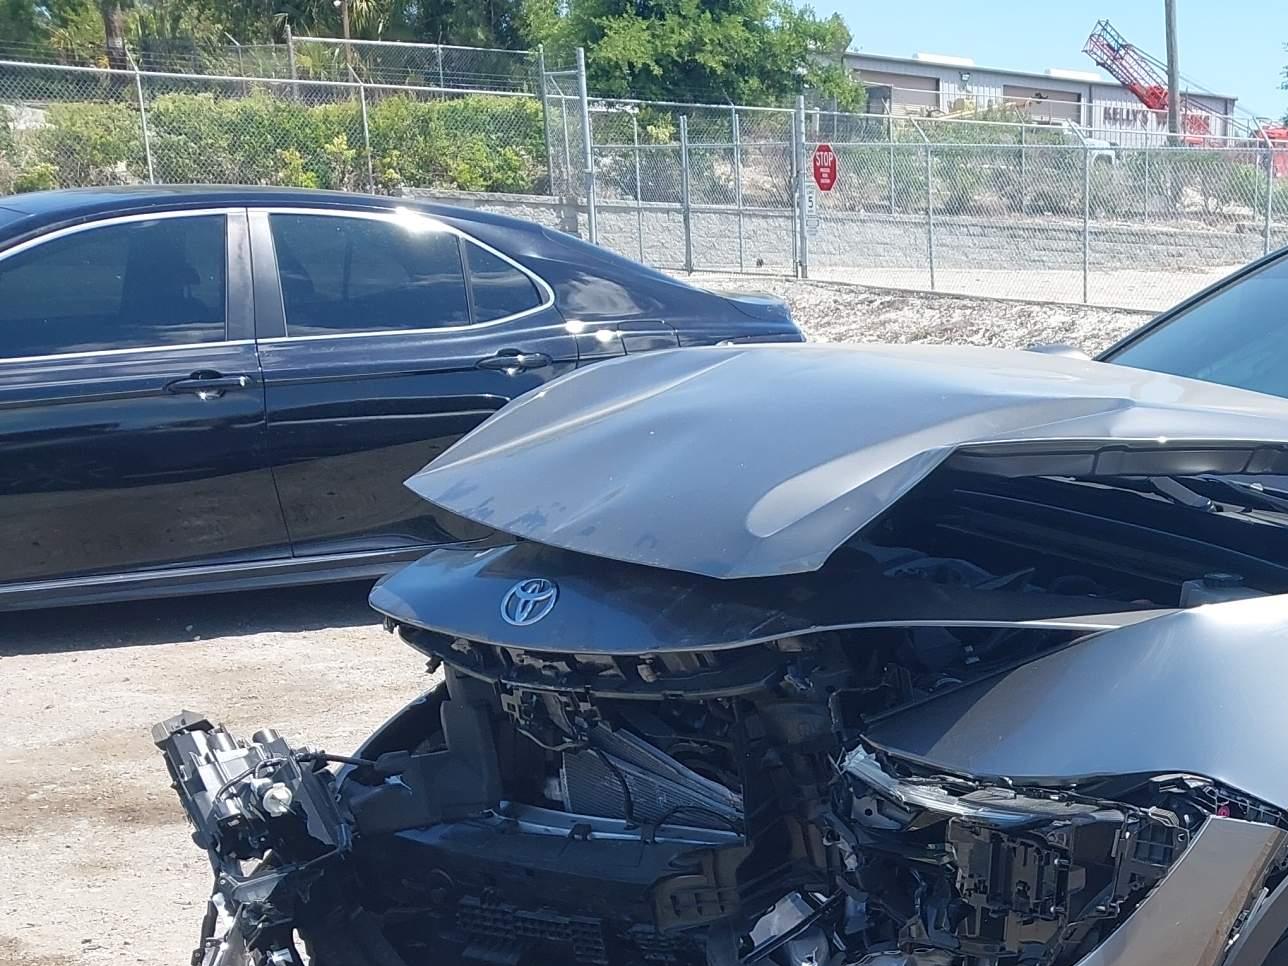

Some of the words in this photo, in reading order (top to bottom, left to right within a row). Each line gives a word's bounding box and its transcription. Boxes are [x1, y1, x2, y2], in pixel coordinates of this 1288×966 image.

[1103, 107, 1149, 123] KELLY'S
[815, 151, 834, 167] STOP
[808, 196, 814, 208] 5
